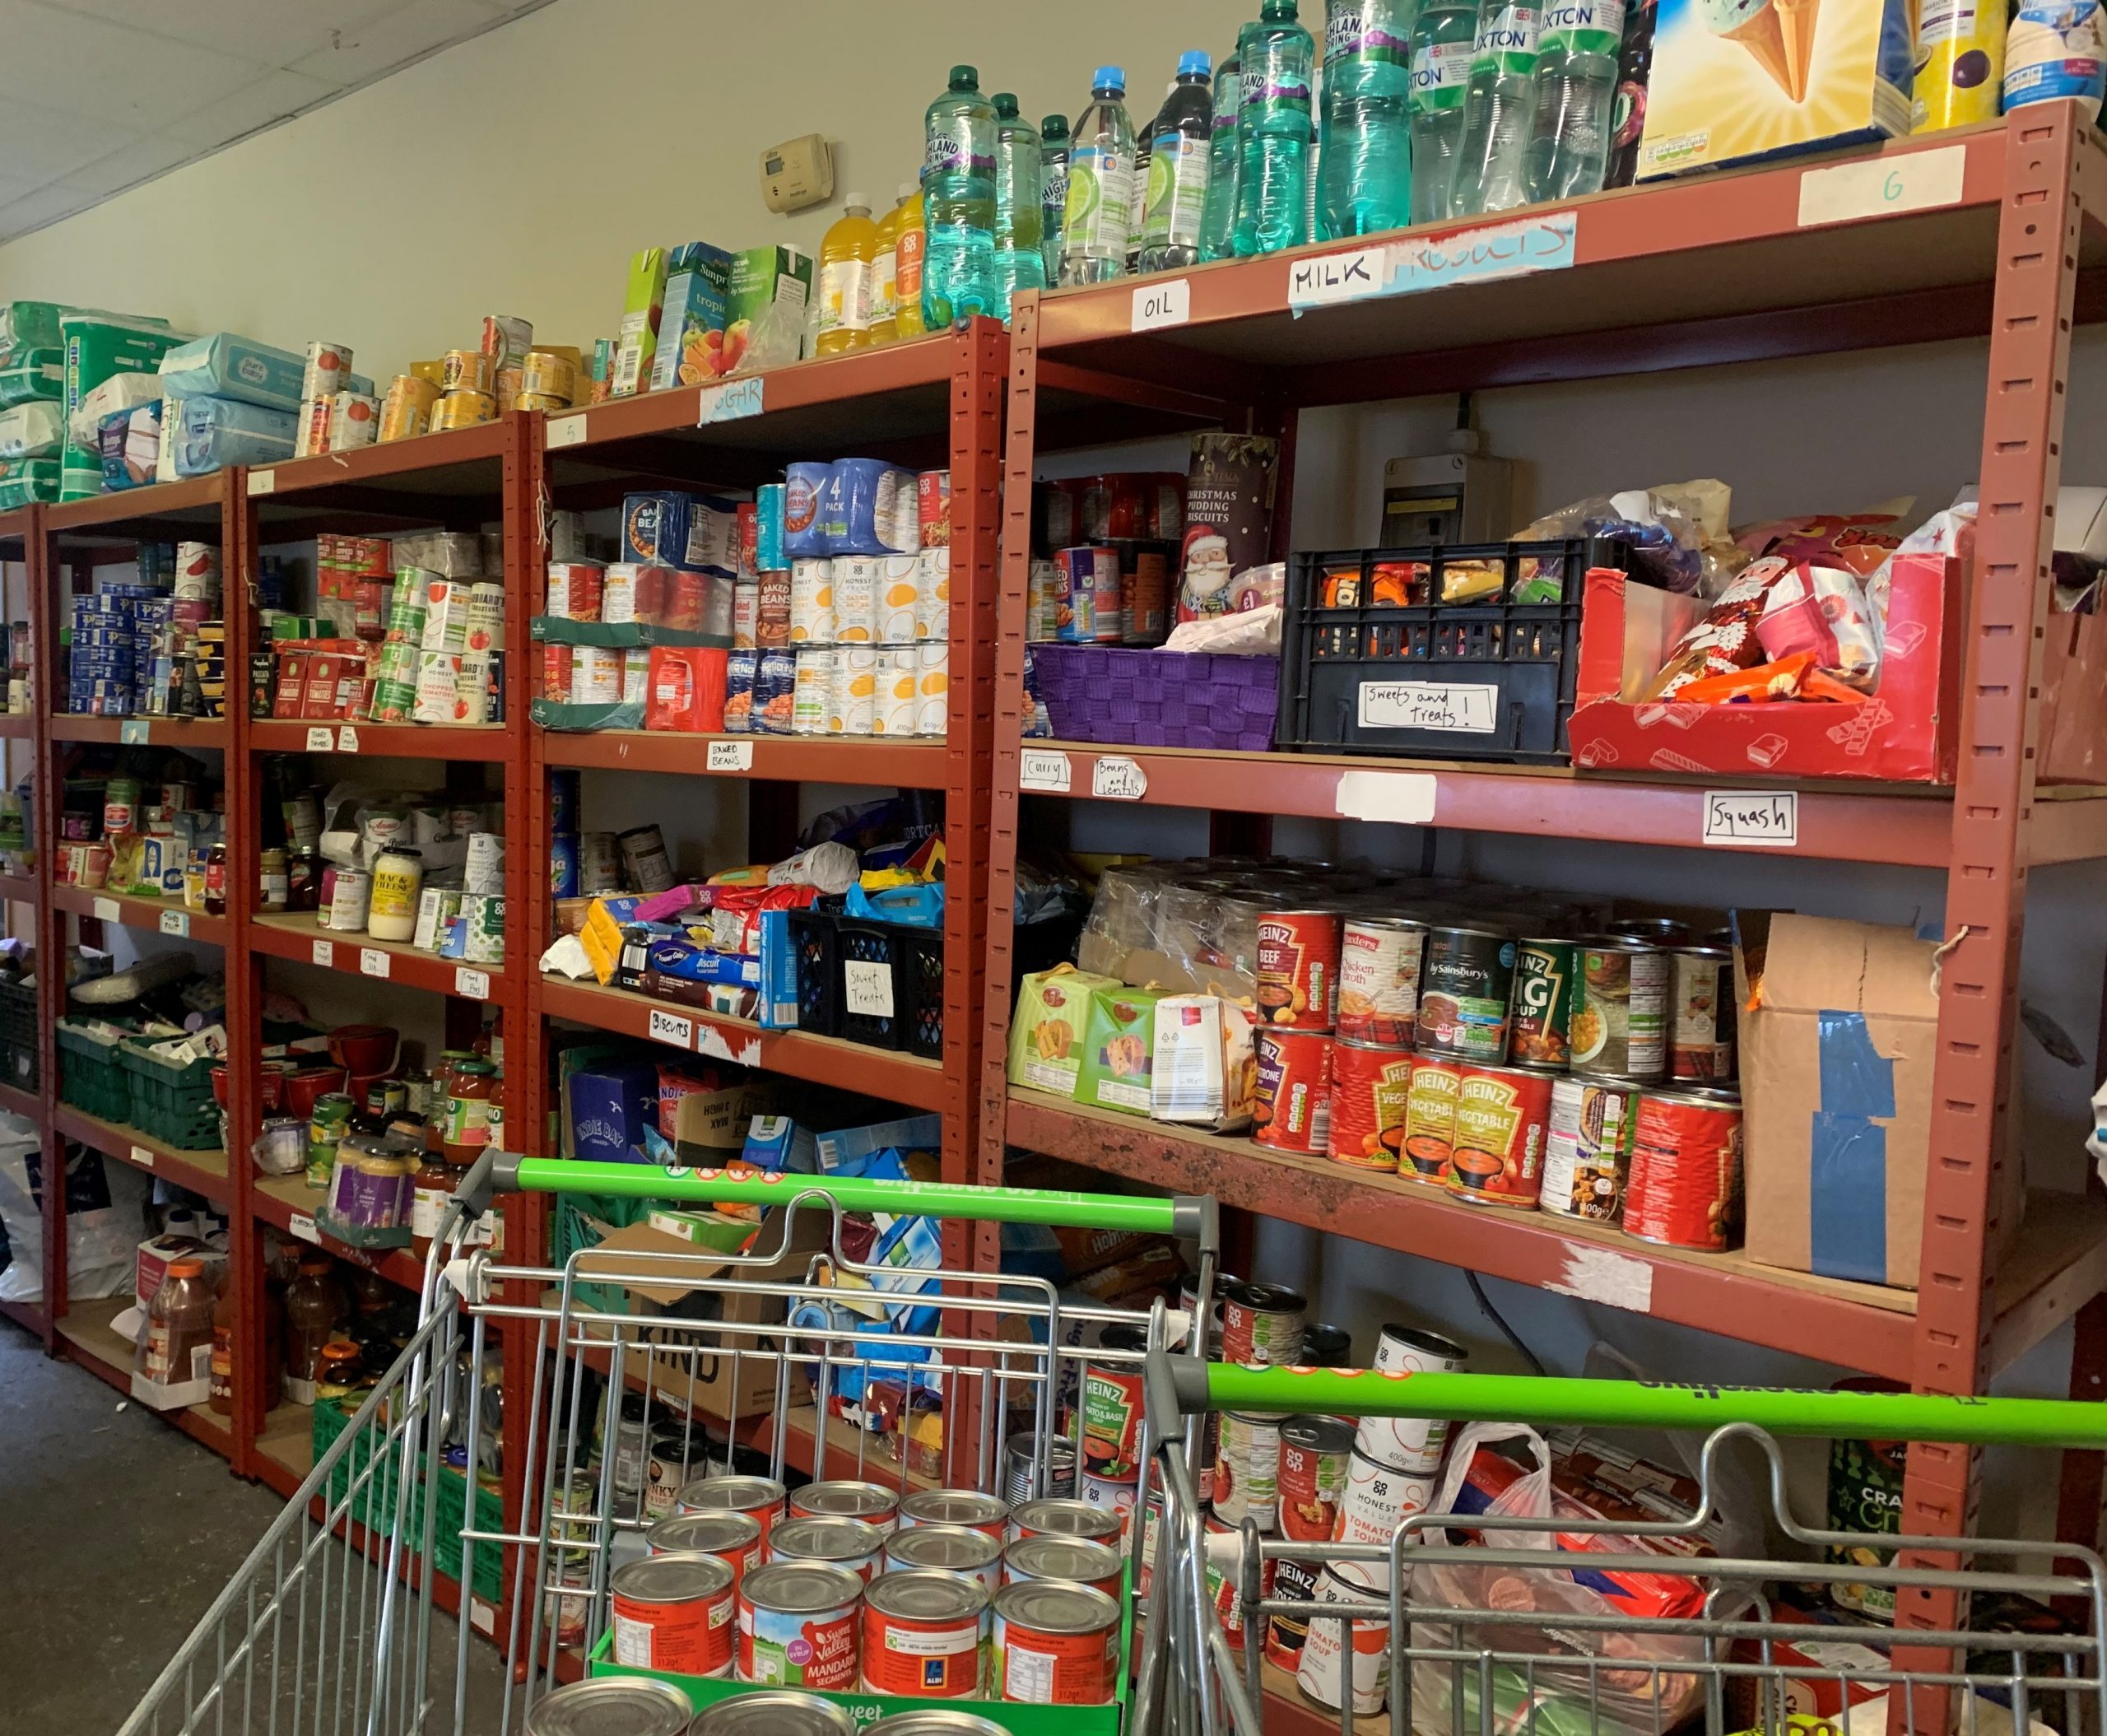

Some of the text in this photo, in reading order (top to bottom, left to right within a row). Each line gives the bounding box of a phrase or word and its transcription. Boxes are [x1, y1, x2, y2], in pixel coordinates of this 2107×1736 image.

[927, 139, 959, 155] HLAND
[700, 263, 728, 285] Sunpr
[1295, 255, 1370, 293] MILK
[696, 294, 725, 314] tropic
[1145, 293, 1173, 317] OIL
[830, 476, 840, 497] 4
[826, 501, 844, 512] PACK
[1187, 501, 1230, 512] PUDDING
[1187, 512, 1230, 523] BISCUITS
[760, 594, 791, 604] BEANS
[764, 584, 789, 594] BAKED
[1417, 688, 1449, 706] and
[712, 756, 740, 766] BEANS
[1713, 797, 1786, 836] Squash
[1258, 926, 1290, 944] HEINZ
[1259, 949, 1281, 964] BEEF
[1438, 964, 1489, 980] Sainsbury's
[653, 1012, 689, 1038] BISCUITS
[1416, 1074, 1459, 1095] HEINZ
[1382, 1092, 1406, 1105] VEGE
[1463, 1084, 1508, 1106] HEINZ
[1410, 1097, 1454, 1118] VEGETABL
[577, 1119, 624, 1148] INDIE BAY
[636, 1325, 719, 1385] KIND
[1086, 1381, 1121, 1403] HEINZ
[1357, 1492, 1398, 1514] HONEST
[1861, 1487, 1903, 1508] CRA
[1357, 1505, 1393, 1523] VALUE
[1349, 1515, 1393, 1538] TOMATO
[1353, 1529, 1383, 1545] SOUP
[1279, 1563, 1315, 1590] HEINZ
[825, 1622, 851, 1644] Sweet
[788, 1649, 810, 1659] SYRUP
[816, 1636, 851, 1661] Valley
[816, 1669, 852, 1687] SEGMENTS
[841, 1704, 883, 1721] weet
